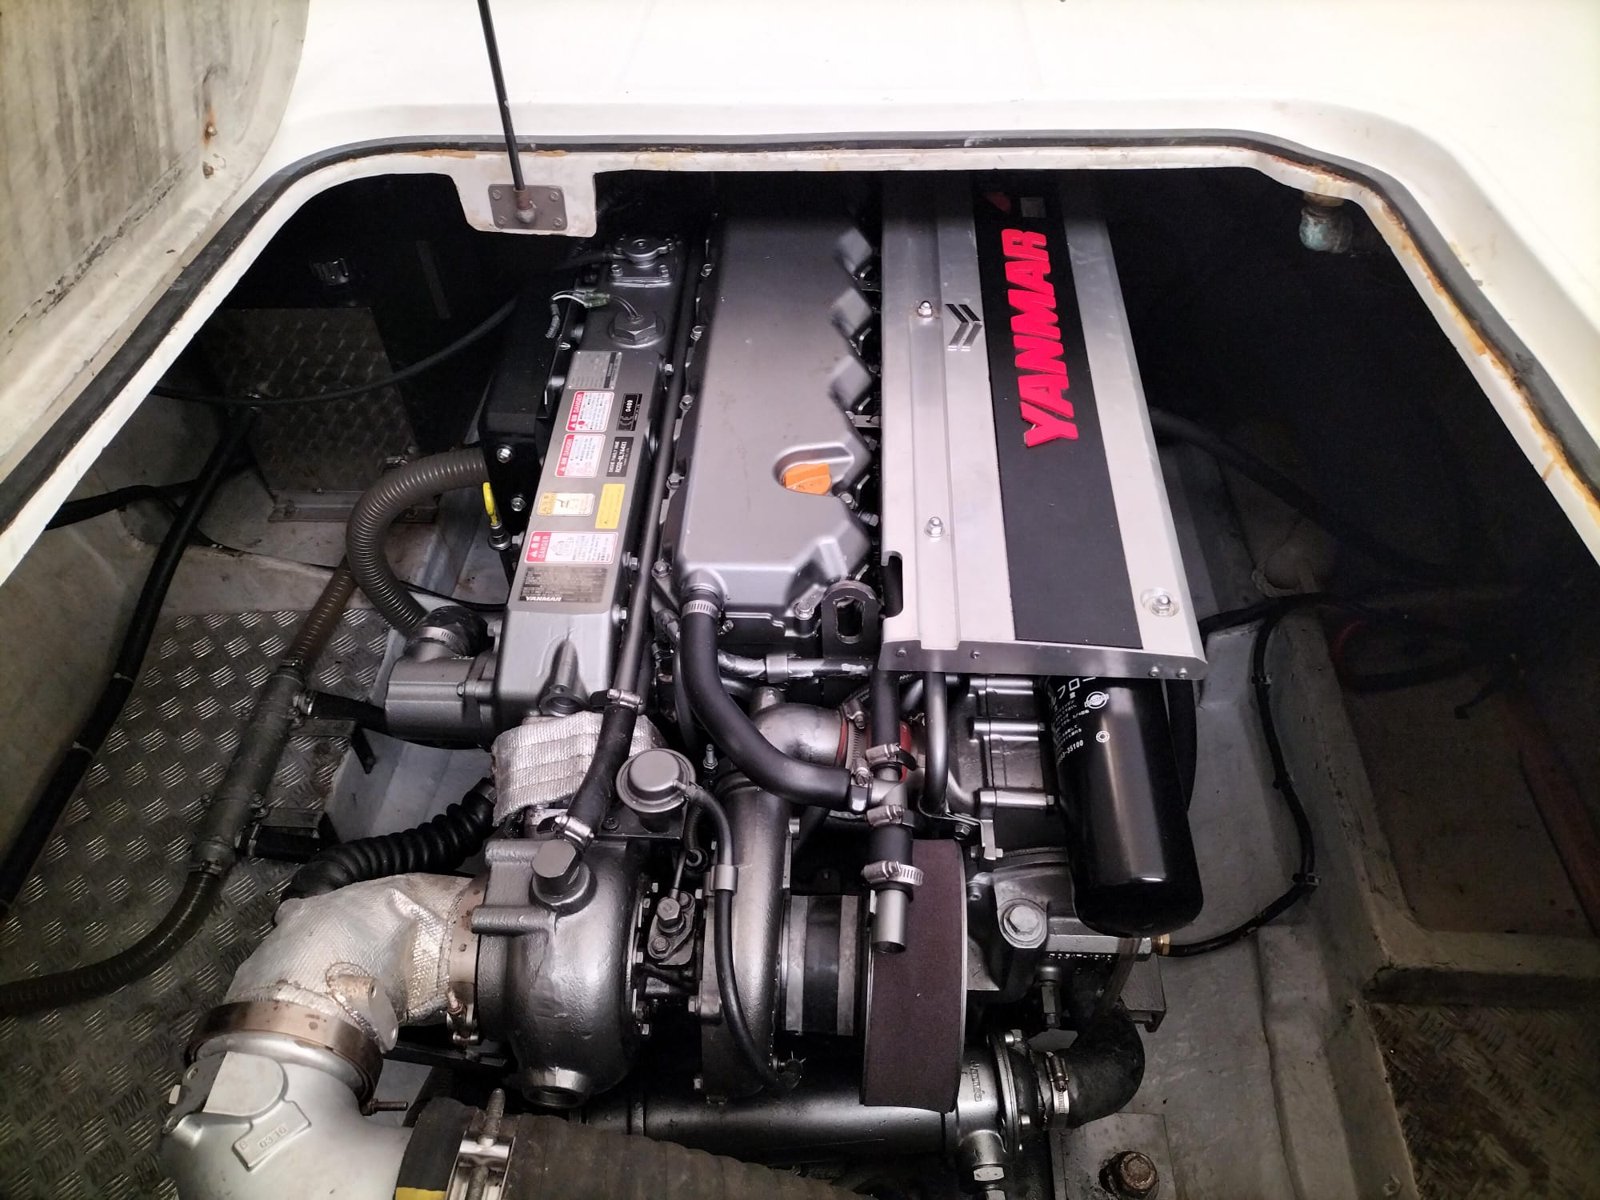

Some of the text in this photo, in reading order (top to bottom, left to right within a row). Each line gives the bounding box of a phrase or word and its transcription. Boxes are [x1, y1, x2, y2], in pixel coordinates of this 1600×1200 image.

[1001, 228, 1079, 448] YANMAR
[573, 394, 584, 413] DANGER
[562, 438, 574, 456] DANGER
[537, 535, 550, 559] DANGER
